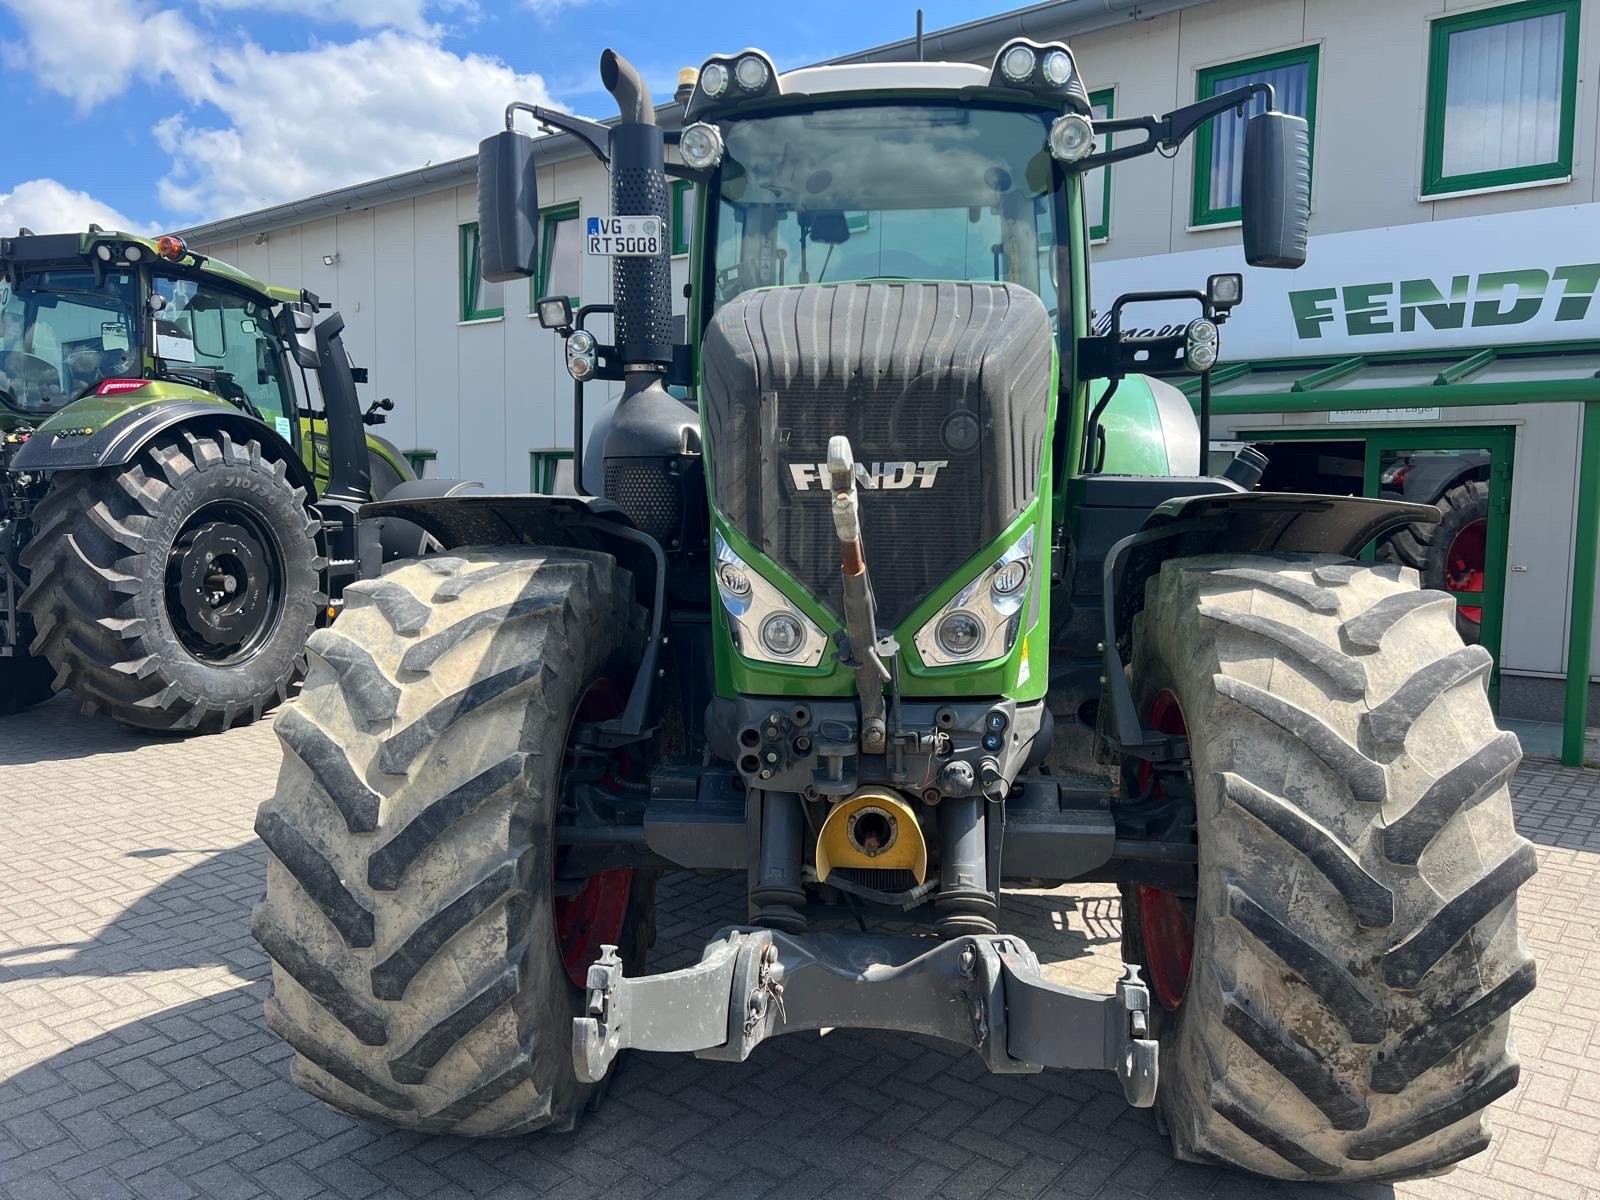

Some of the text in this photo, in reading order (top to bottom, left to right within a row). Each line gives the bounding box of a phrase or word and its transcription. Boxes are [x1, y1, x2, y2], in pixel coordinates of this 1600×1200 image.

[600, 218, 623, 235] VG
[591, 236, 658, 253] RT 5008
[1288, 263, 1600, 339] FENDT
